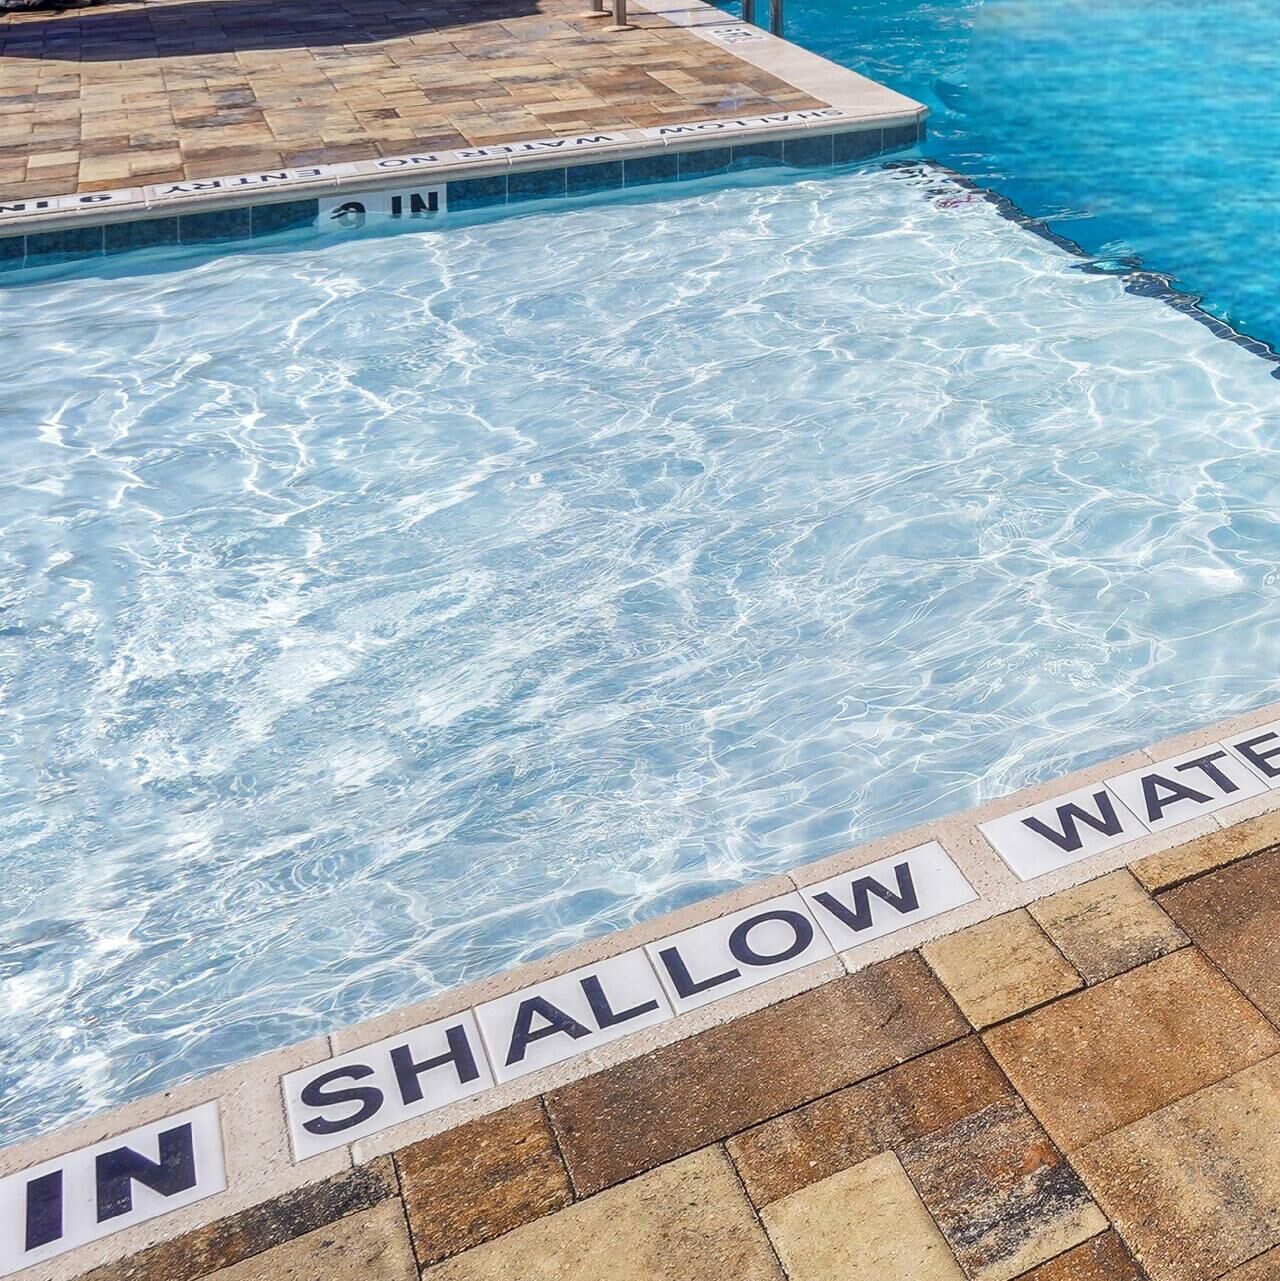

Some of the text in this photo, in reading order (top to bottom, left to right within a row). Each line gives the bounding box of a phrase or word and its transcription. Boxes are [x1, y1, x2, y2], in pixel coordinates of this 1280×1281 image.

[660, 110, 843, 135] SHALLOW
[461, 136, 614, 158] WATER
[379, 155, 438, 167] NO
[164, 169, 321, 194] ENTRY
[391, 191, 438, 216] IN
[24, 1121, 197, 1251] IN
[300, 861, 920, 1136] SHALLOW
